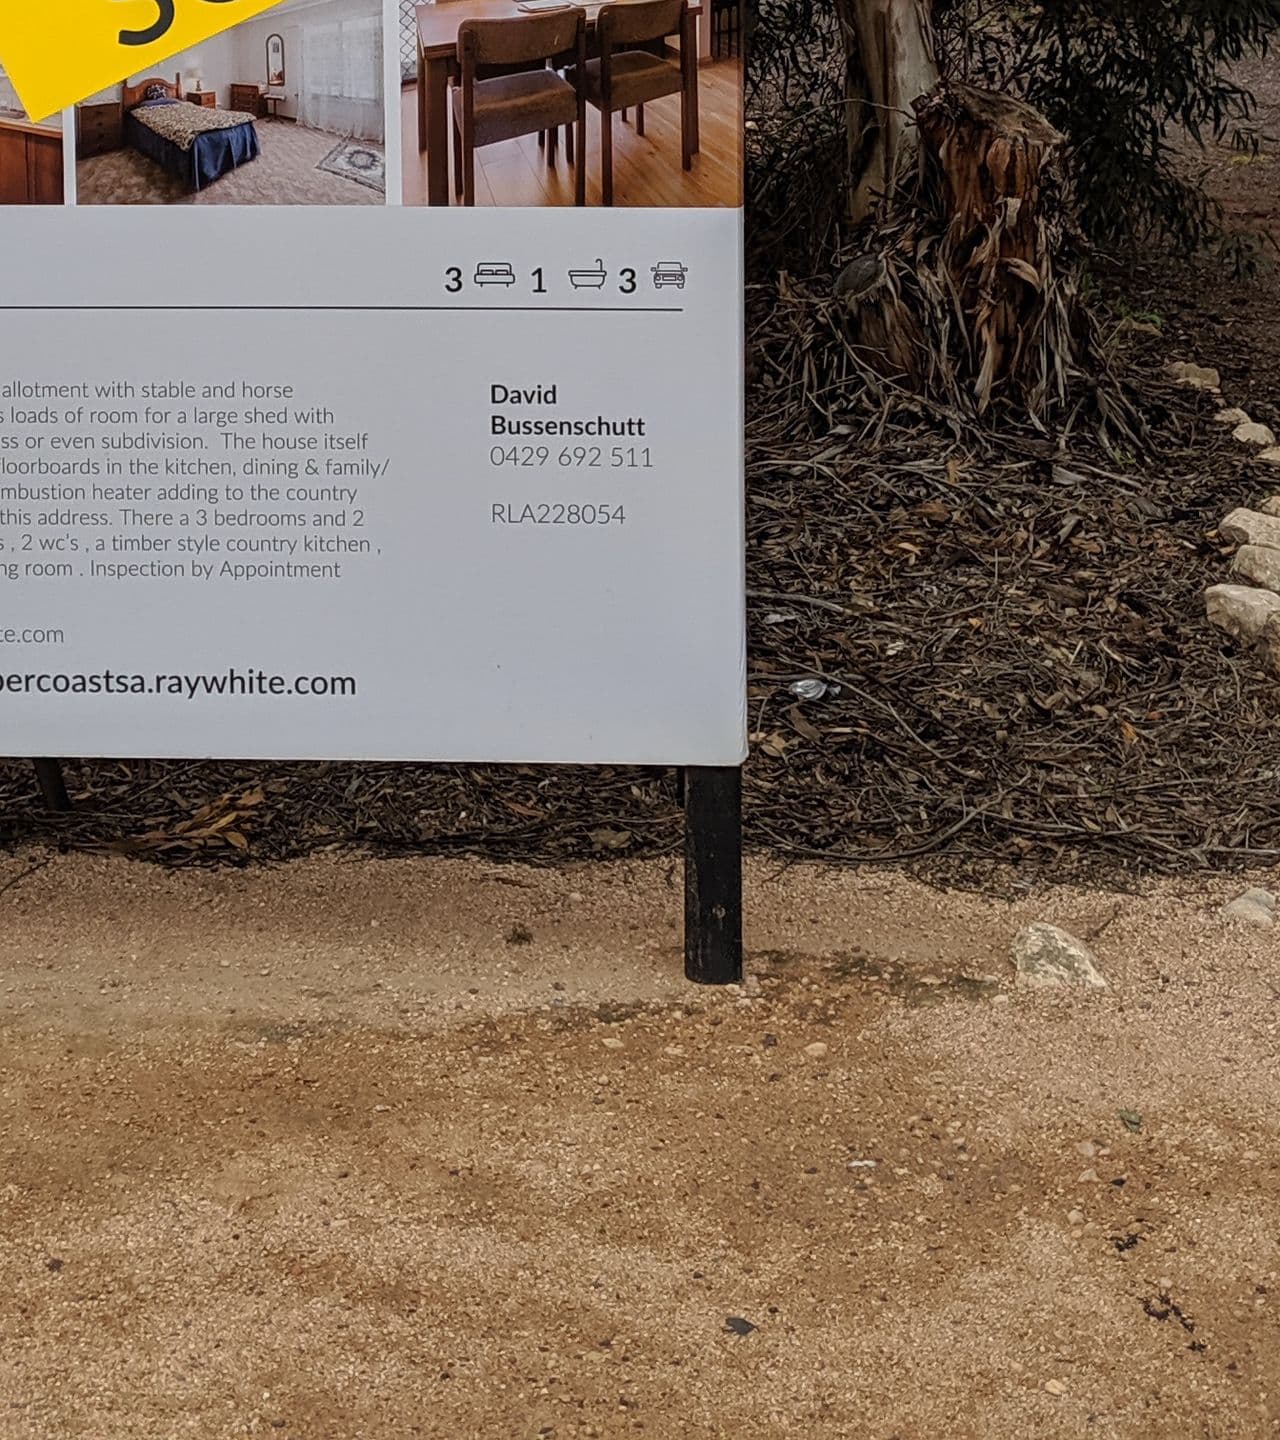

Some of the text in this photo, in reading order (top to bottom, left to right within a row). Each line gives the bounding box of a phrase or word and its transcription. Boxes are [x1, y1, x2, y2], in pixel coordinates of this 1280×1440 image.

[443, 266, 638, 295] 3 1 3
[2, 380, 89, 398] allotment
[95, 381, 134, 398] with
[141, 381, 196, 398] stable
[202, 381, 235, 398] and
[243, 381, 293, 398] horse
[491, 384, 557, 405] David
[11, 406, 58, 424] loads
[65, 406, 84, 424] of
[90, 411, 137, 424] room
[145, 407, 171, 424] for
[177, 411, 186, 424] a
[194, 406, 238, 427] large
[244, 406, 287, 424] shed
[294, 407, 333, 424] with
[491, 415, 645, 436] Bussenschutt
[25, 437, 45, 449] or
[51, 437, 94, 449] even
[102, 432, 208, 450] subdivision.
[220, 432, 256, 449] The
[263, 432, 317, 449] house
[325, 433, 368, 450] itself
[490, 446, 653, 467] 0429 692 511
[105, 458, 122, 475] in
[129, 458, 158, 475] the
[165, 458, 236, 477] kitchen,
[243, 458, 299, 479] dining
[325, 458, 390, 479] family/
[93, 482, 152, 500] heater
[157, 483, 219, 504] adding
[225, 485, 243, 501] to
[250, 483, 279, 501] the
[286, 485, 357, 504] country
[0, 508, 31, 525] this
[38, 508, 112, 526] address.
[119, 509, 173, 526] There
[180, 514, 189, 526] a
[196, 509, 207, 526] 3
[215, 509, 306, 526] bedrooms
[313, 509, 345, 526] and
[352, 510, 364, 526] 2
[492, 504, 626, 524] RLA228054
[22, 534, 32, 551] 2
[39, 533, 78, 551] wc's
[96, 539, 105, 551] a
[112, 534, 172, 551] timber
[178, 534, 220, 555] style
[226, 536, 297, 555] country
[304, 535, 370, 552] kitchen
[26, 563, 72, 576] room
[91, 560, 184, 580] Inspection
[192, 560, 214, 580] by
[220, 560, 341, 581] Appointment
